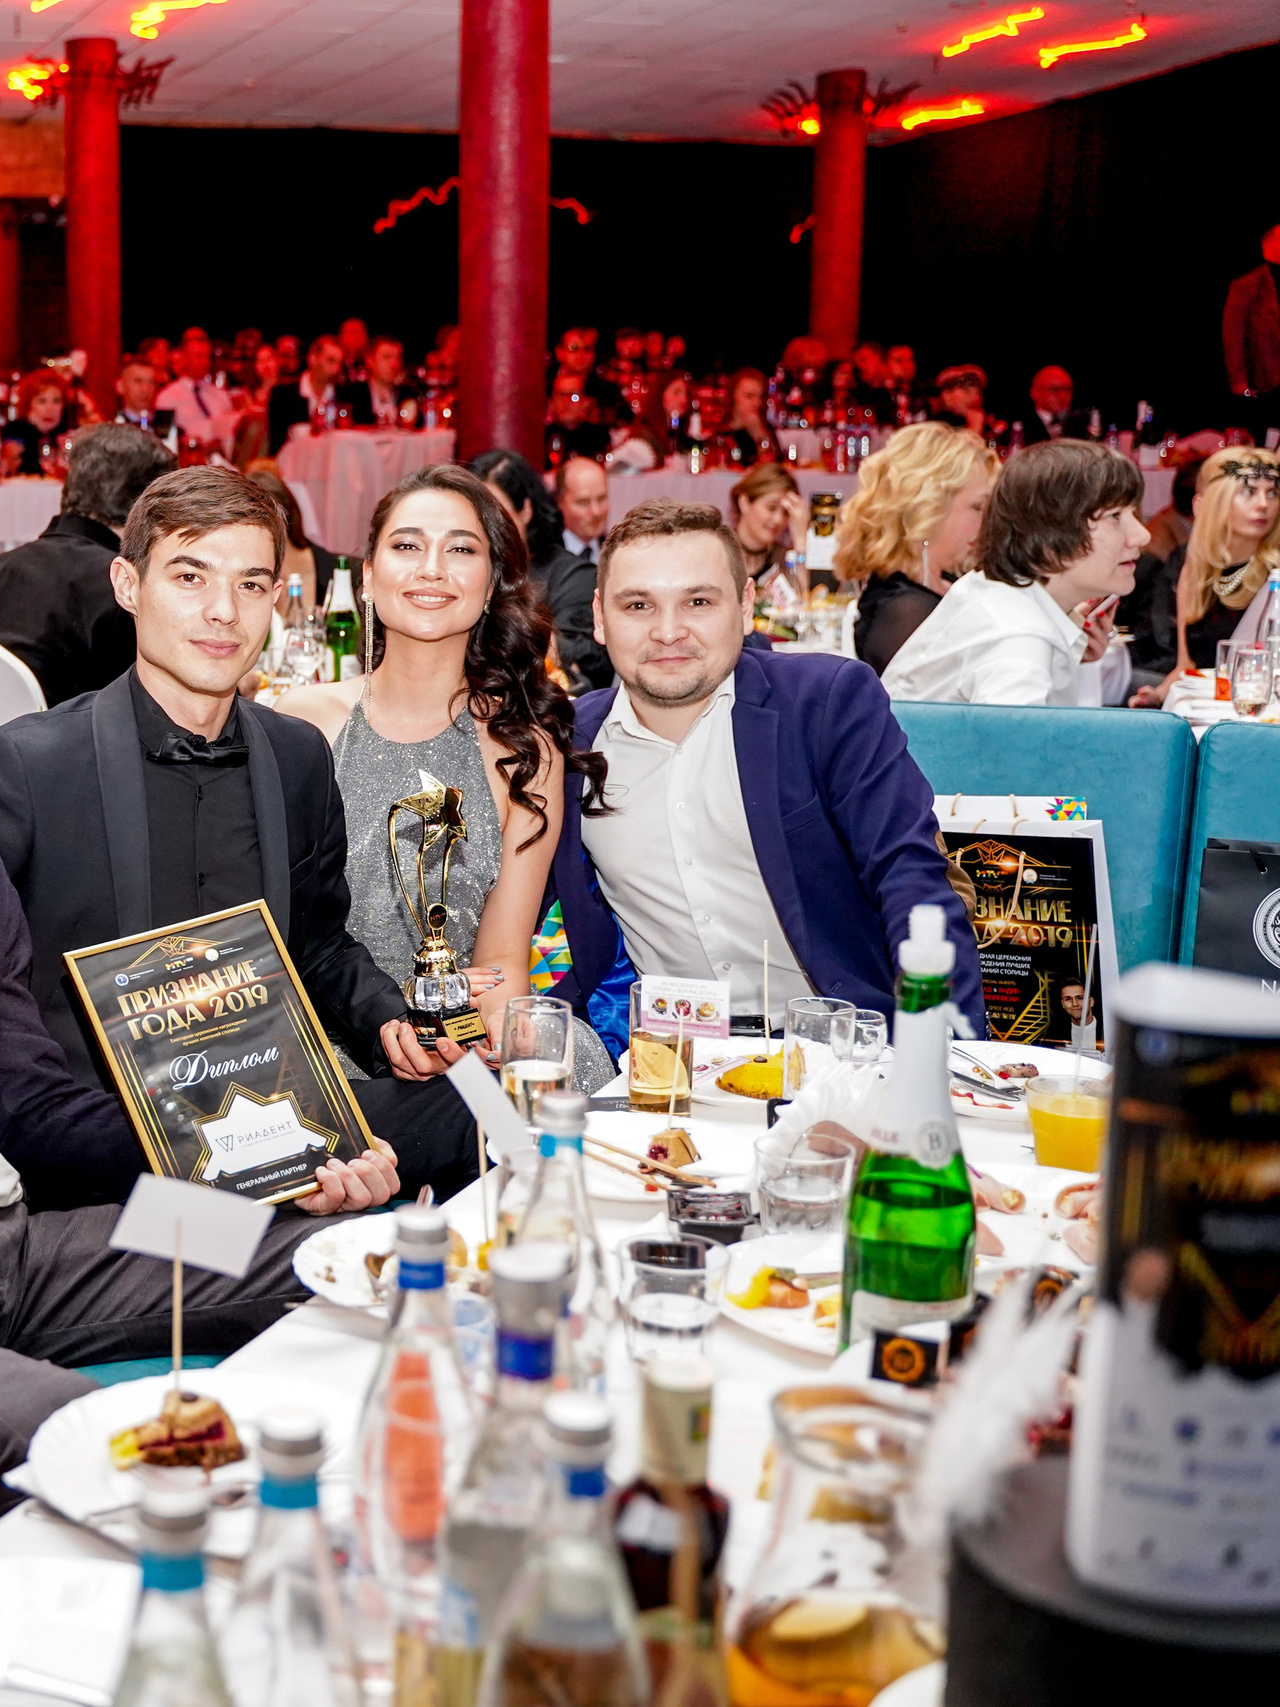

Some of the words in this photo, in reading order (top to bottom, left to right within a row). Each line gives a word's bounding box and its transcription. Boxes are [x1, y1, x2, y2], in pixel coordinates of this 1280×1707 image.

[974, 896, 1072, 923] ЗНАНИЕ
[1009, 925, 1073, 948] 2019
[996, 954, 1031, 962] ЦЕРЕМОНИЯ
[1000, 968, 1029, 976] СТОЛИЦЫ
[117, 959, 261, 1017] ПРИЗНАНИЕ
[126, 1002, 206, 1041] ГОДА
[209, 984, 269, 1018] 2019
[169, 1047, 280, 1091] Диплом
[236, 1170, 281, 1191] ГЕНЕРАЛЬНЫЙ
[279, 1163, 308, 1178] ПАРТНЕР
